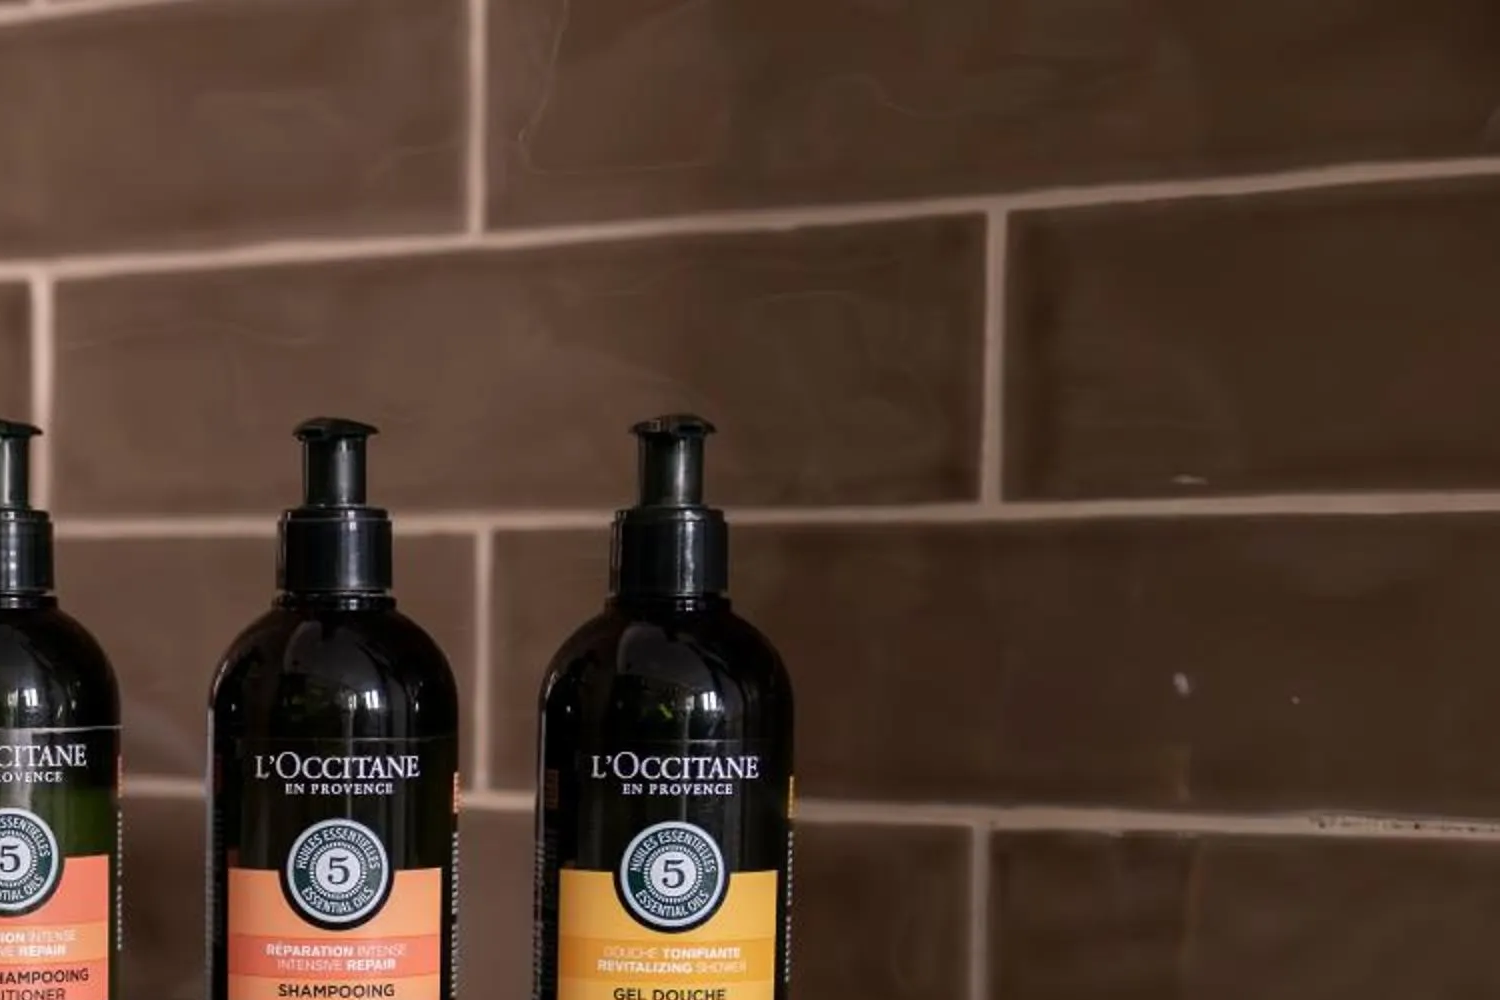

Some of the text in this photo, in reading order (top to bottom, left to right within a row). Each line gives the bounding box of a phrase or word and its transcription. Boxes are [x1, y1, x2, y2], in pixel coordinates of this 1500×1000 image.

[254, 751, 421, 780] L'OCCITANE
[591, 751, 759, 780] L'OCCITANE
[285, 783, 394, 795] EN PROVENCE
[623, 783, 733, 795] EN PROVENCE
[327, 856, 350, 885] 5
[661, 859, 686, 889] 5
[265, 942, 354, 957] RÉPARATION
[346, 958, 396, 971] REPAIR
[597, 960, 693, 974] REVITALIZING
[277, 983, 395, 999] SHAMPOOING
